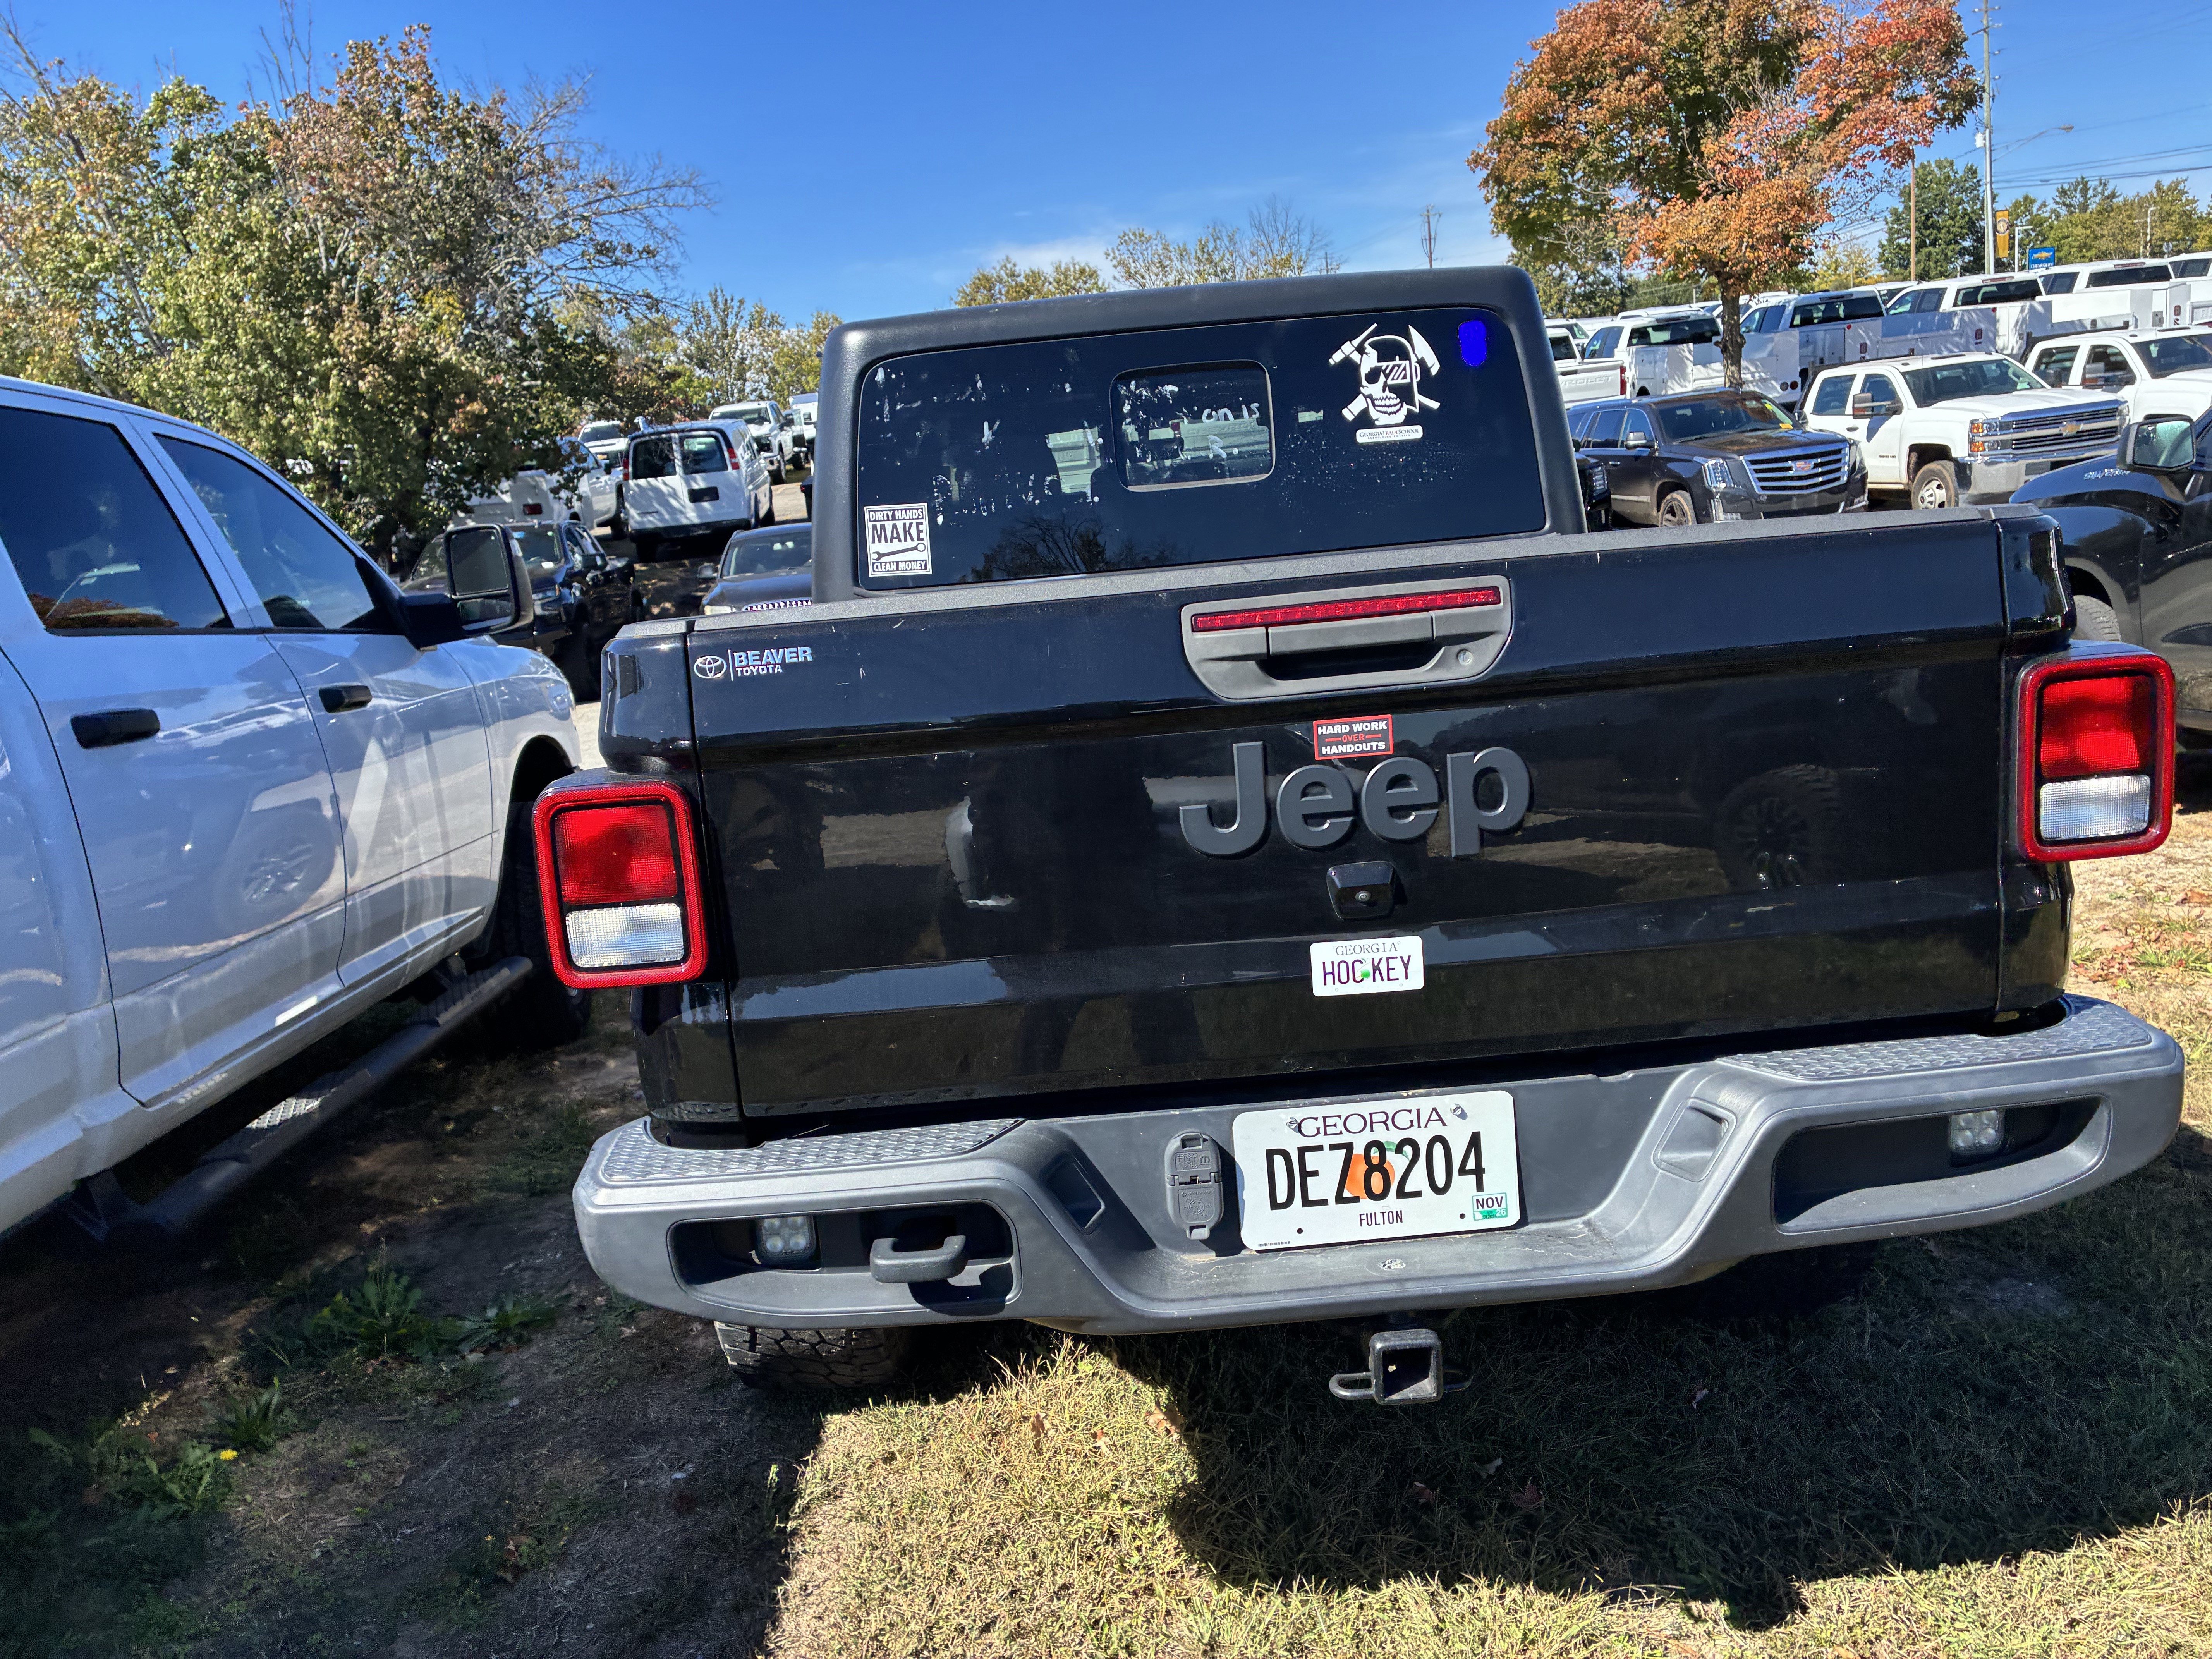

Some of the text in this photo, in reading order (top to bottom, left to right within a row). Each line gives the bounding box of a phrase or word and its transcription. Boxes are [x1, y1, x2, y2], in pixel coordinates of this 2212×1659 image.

[869, 509, 923, 521] DIRTY HANDS
[871, 522, 925, 544] MAKE
[873, 560, 926, 572] CLEAN MONEY
[733, 647, 813, 667] BEAVER
[736, 665, 783, 677] TOYOTA
[1318, 721, 1388, 735] HARD WORK
[1342, 733, 1365, 742] OVER
[1322, 741, 1386, 755] HANDOUTS
[1179, 740, 1530, 858] Jeep
[1336, 942, 1398, 956] GEORGIA
[1322, 955, 1411, 986] HOCKEY
[1297, 1107, 1448, 1138] GEORGIA
[1265, 1131, 1486, 1211] DEZ8204
[1476, 1196, 1503, 1209] NOV
[1359, 1209, 1403, 1227] FULTON
